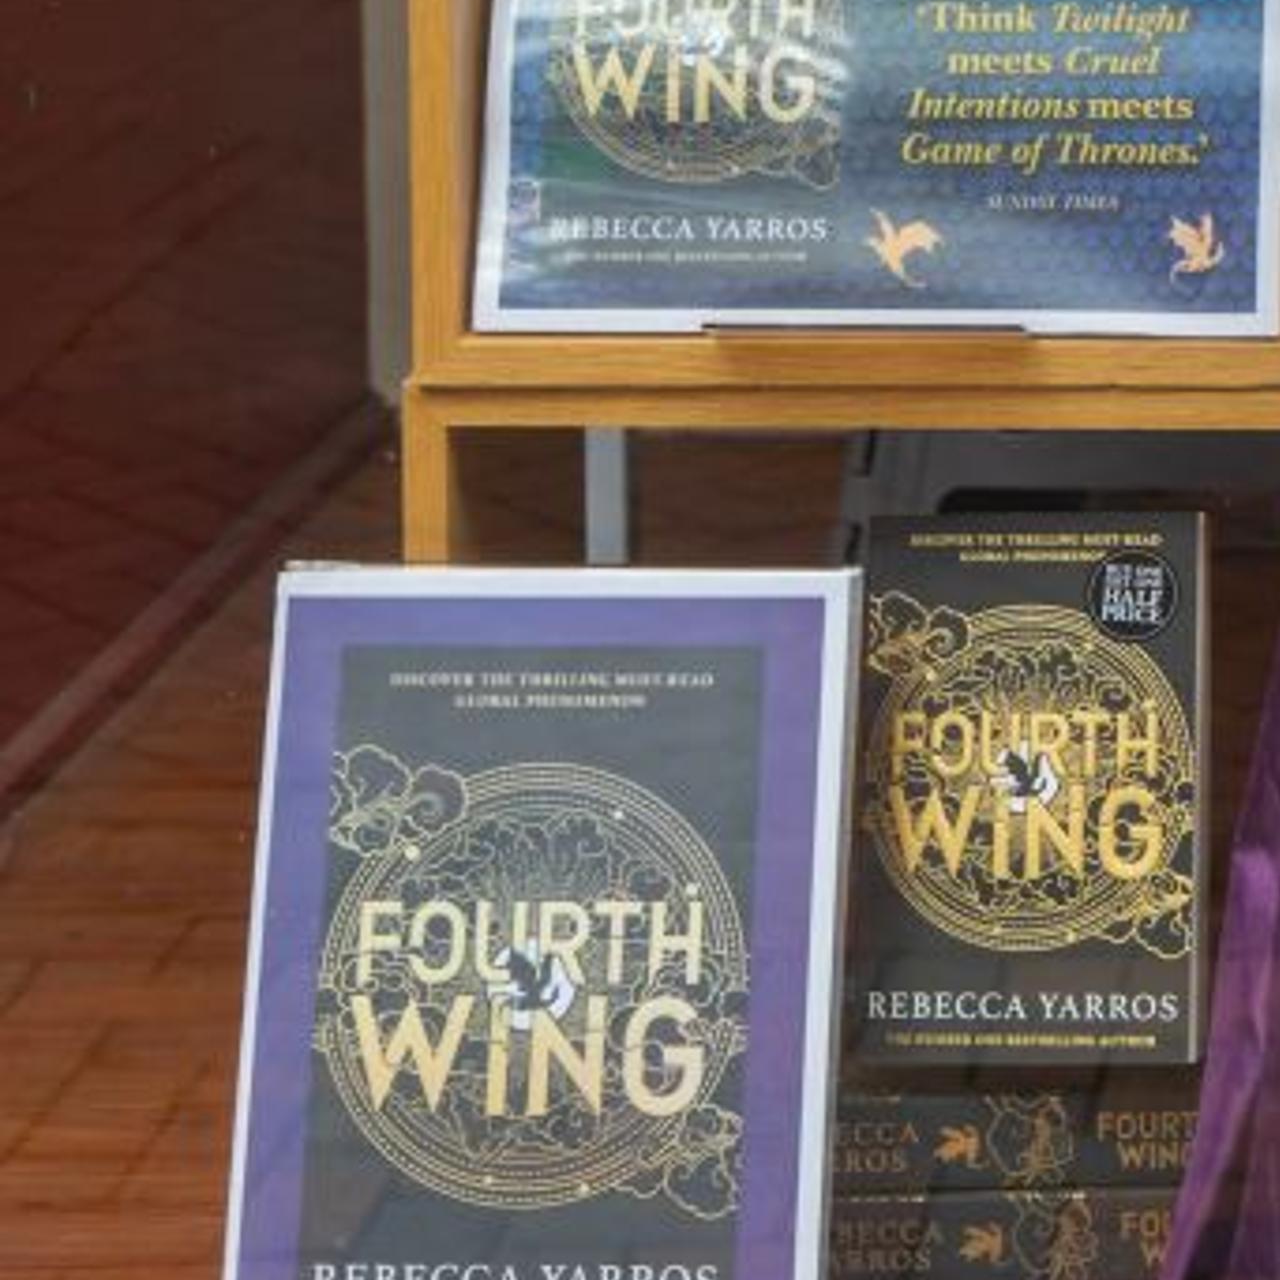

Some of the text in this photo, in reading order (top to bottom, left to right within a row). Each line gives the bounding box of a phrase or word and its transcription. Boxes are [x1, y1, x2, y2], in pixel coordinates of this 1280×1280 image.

[1050, 0, 1192, 46] Twilight
[946, 46, 1162, 76] meets Cruel
[571, 39, 818, 125] WING
[906, 87, 1195, 121] Intentions meets
[900, 132, 1003, 166] Game
[1010, 132, 1050, 176] of
[548, 215, 829, 242] REBECCA YARROS
[1101, 605, 1163, 623] PRICE
[1104, 589, 1164, 607] HALF
[891, 708, 1162, 780] FOURTH
[888, 782, 1164, 880] WING
[353, 899, 704, 987] FOURTH
[868, 990, 1180, 1021] REBECCA YARROS
[350, 993, 706, 1119] WING
[1097, 1110, 1200, 1142] FOURT
